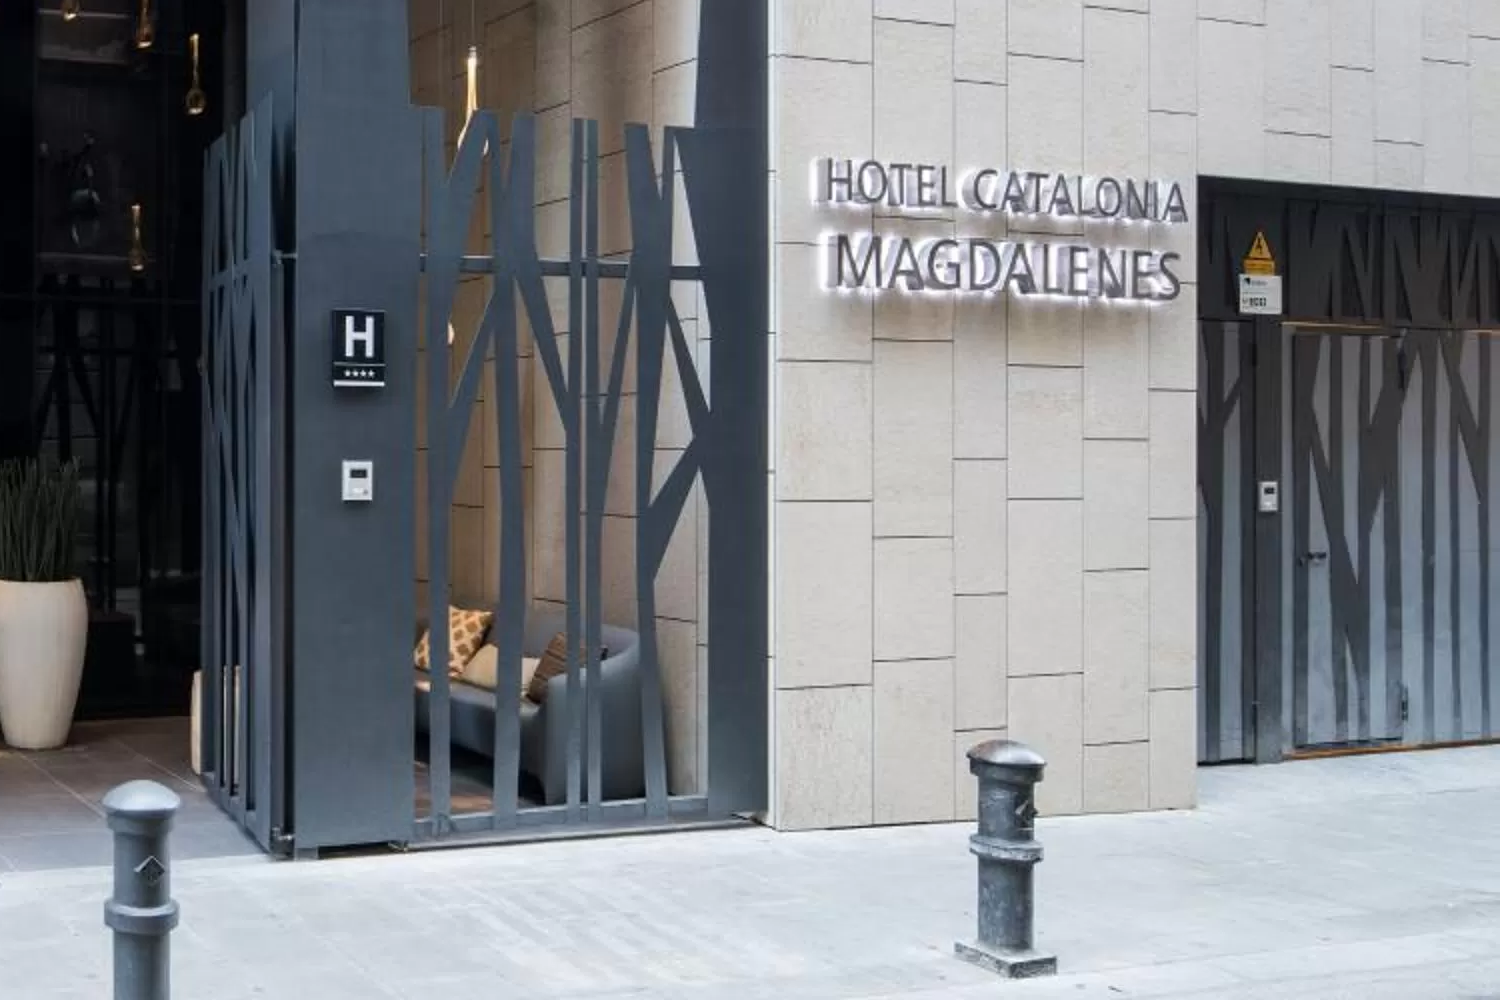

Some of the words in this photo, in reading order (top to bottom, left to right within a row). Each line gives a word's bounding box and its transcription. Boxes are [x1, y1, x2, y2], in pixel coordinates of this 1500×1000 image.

[825, 157, 958, 209] HOTEL
[972, 168, 1189, 223] CATALONIA
[836, 233, 1182, 301] MAGDALENES
[345, 315, 375, 358] H
